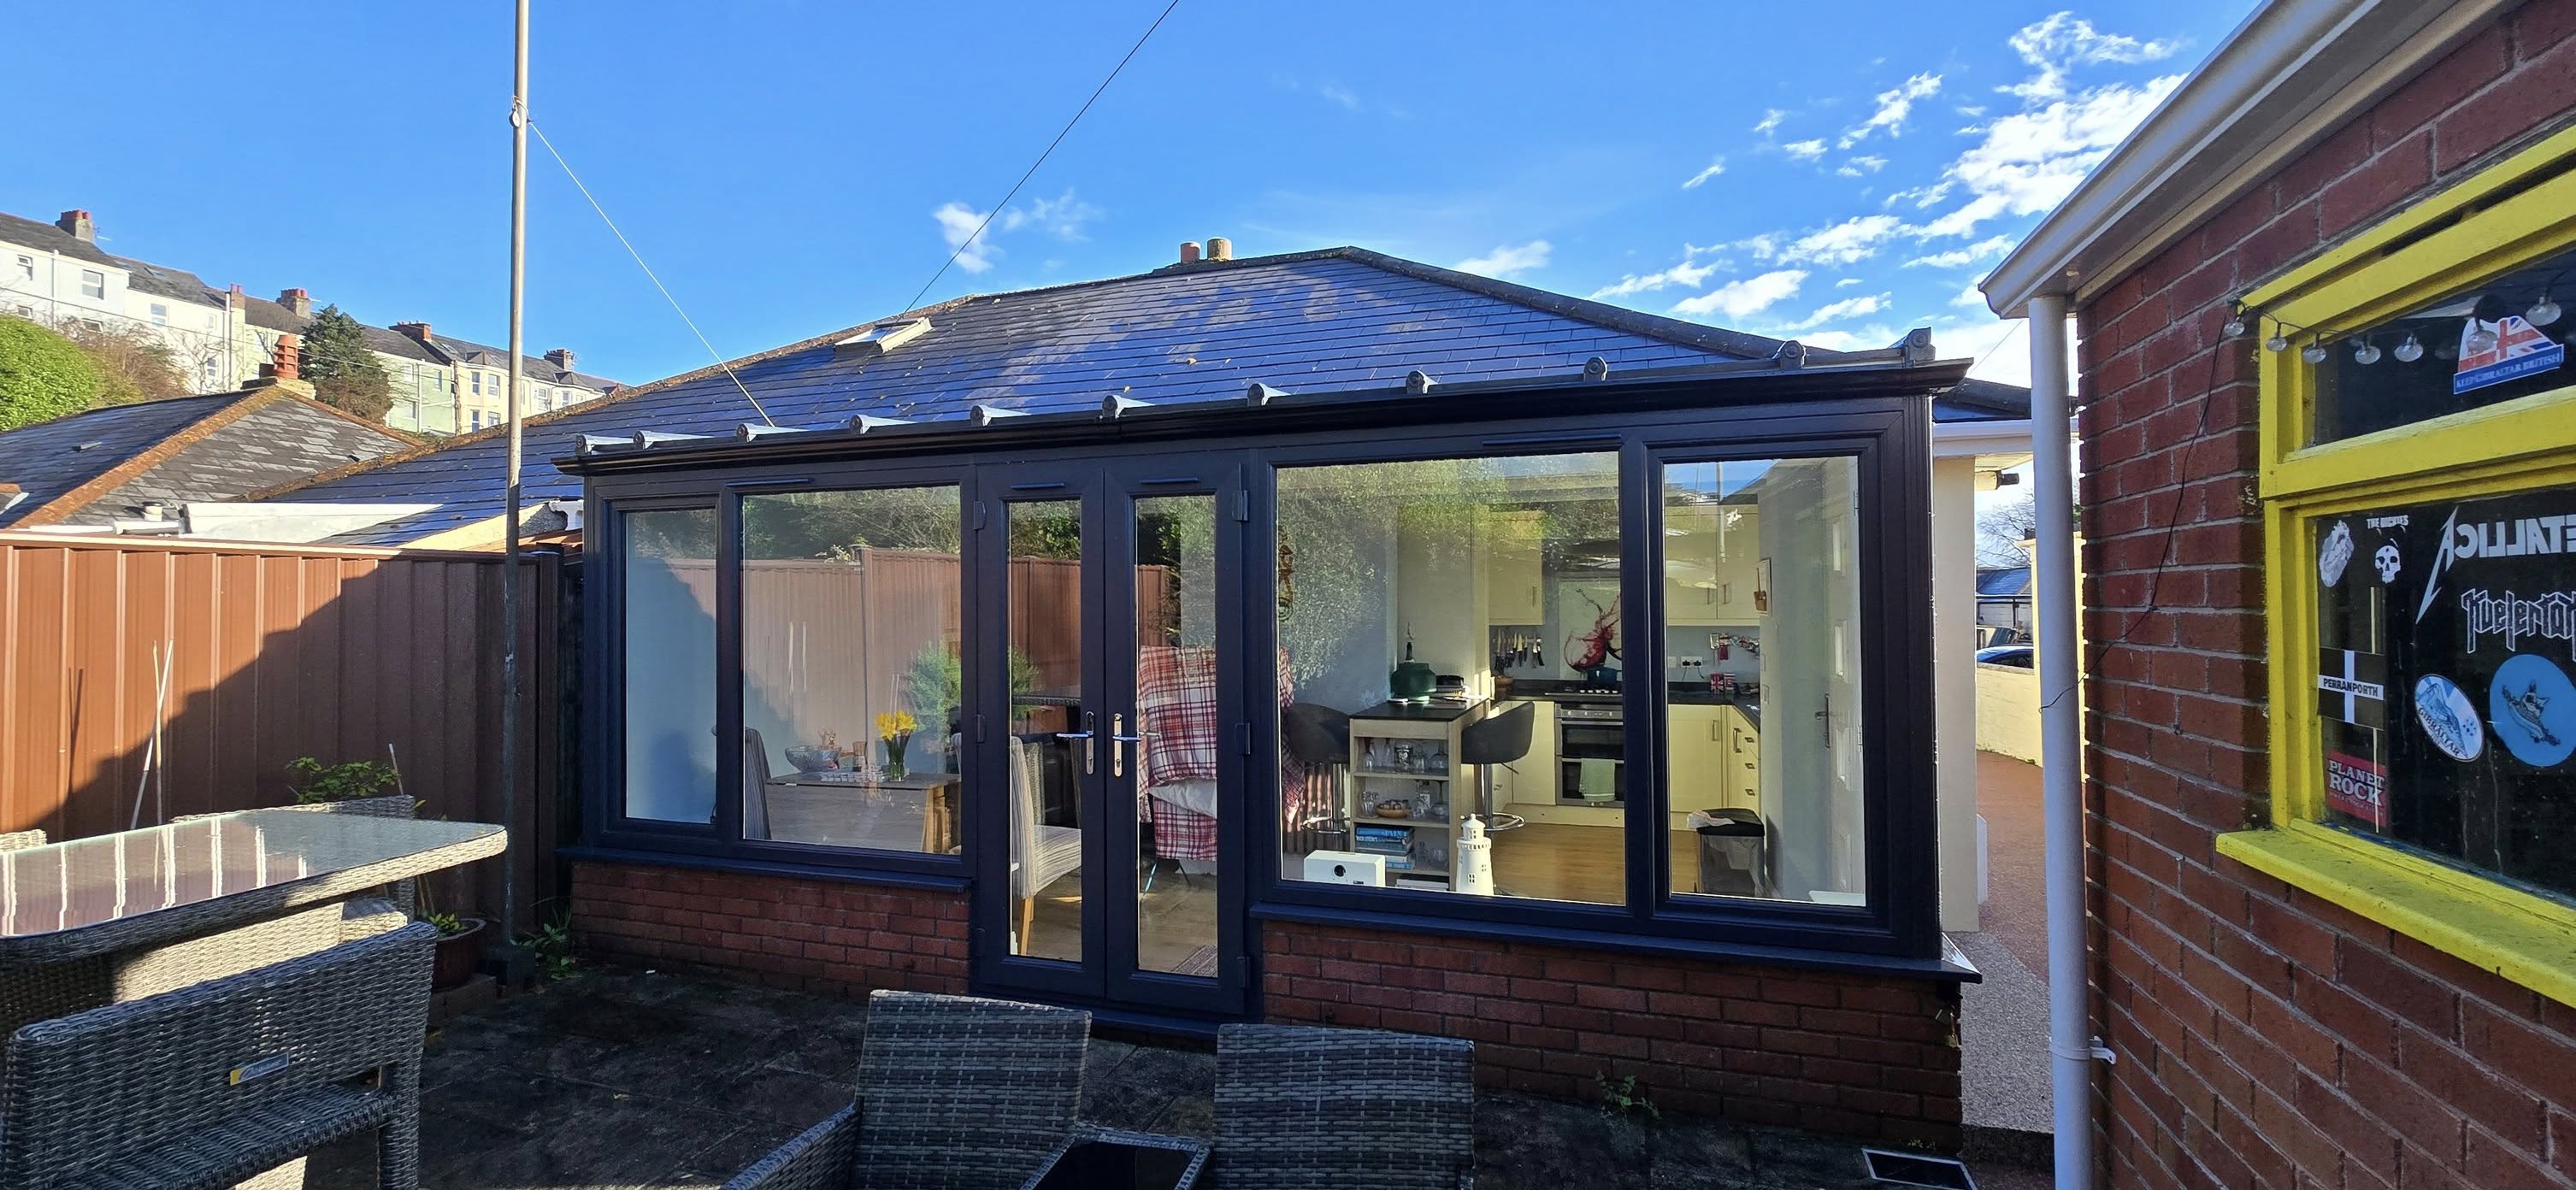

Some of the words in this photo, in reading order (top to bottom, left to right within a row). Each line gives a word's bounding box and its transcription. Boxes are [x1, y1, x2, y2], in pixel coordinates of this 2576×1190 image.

[2476, 363, 2521, 383] GIBRALTAR
[2523, 353, 2560, 370] BRITISH
[2461, 588, 2576, 663] Kvelerta
[2323, 678, 2379, 697] PERRANPORTH
[2418, 707, 2460, 756] GIBRALTAR
[2329, 760, 2384, 788] PLANET
[2329, 773, 2383, 806] ROCK
